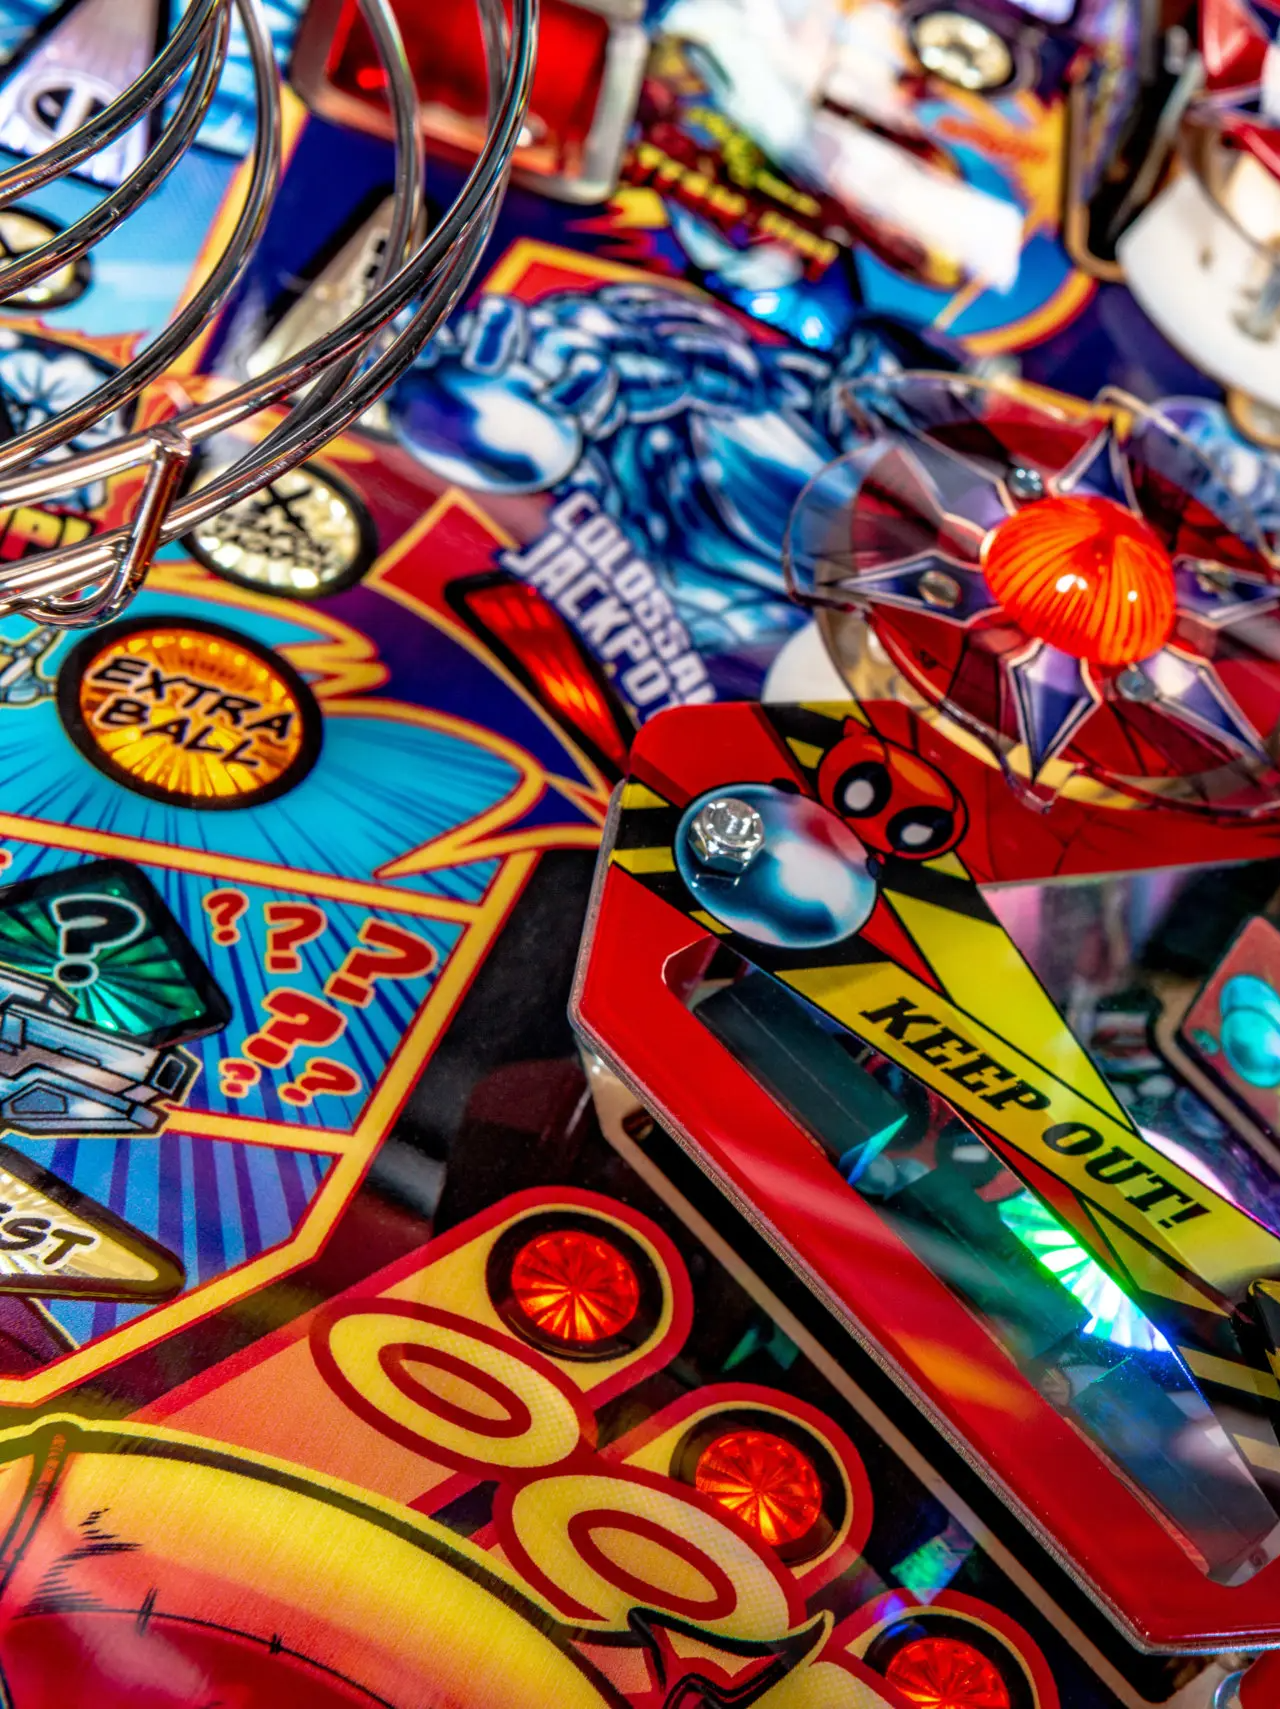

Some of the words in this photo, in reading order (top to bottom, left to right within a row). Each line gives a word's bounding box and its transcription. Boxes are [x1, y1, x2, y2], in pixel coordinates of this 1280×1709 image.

[501, 530, 682, 720] JACKPO
[89, 656, 294, 740] EXTRA
[97, 697, 261, 768] BALL
[859, 997, 1051, 1111] KEEP
[1041, 1122, 1211, 1229] OUT!
[0, 1202, 96, 1265] ST
